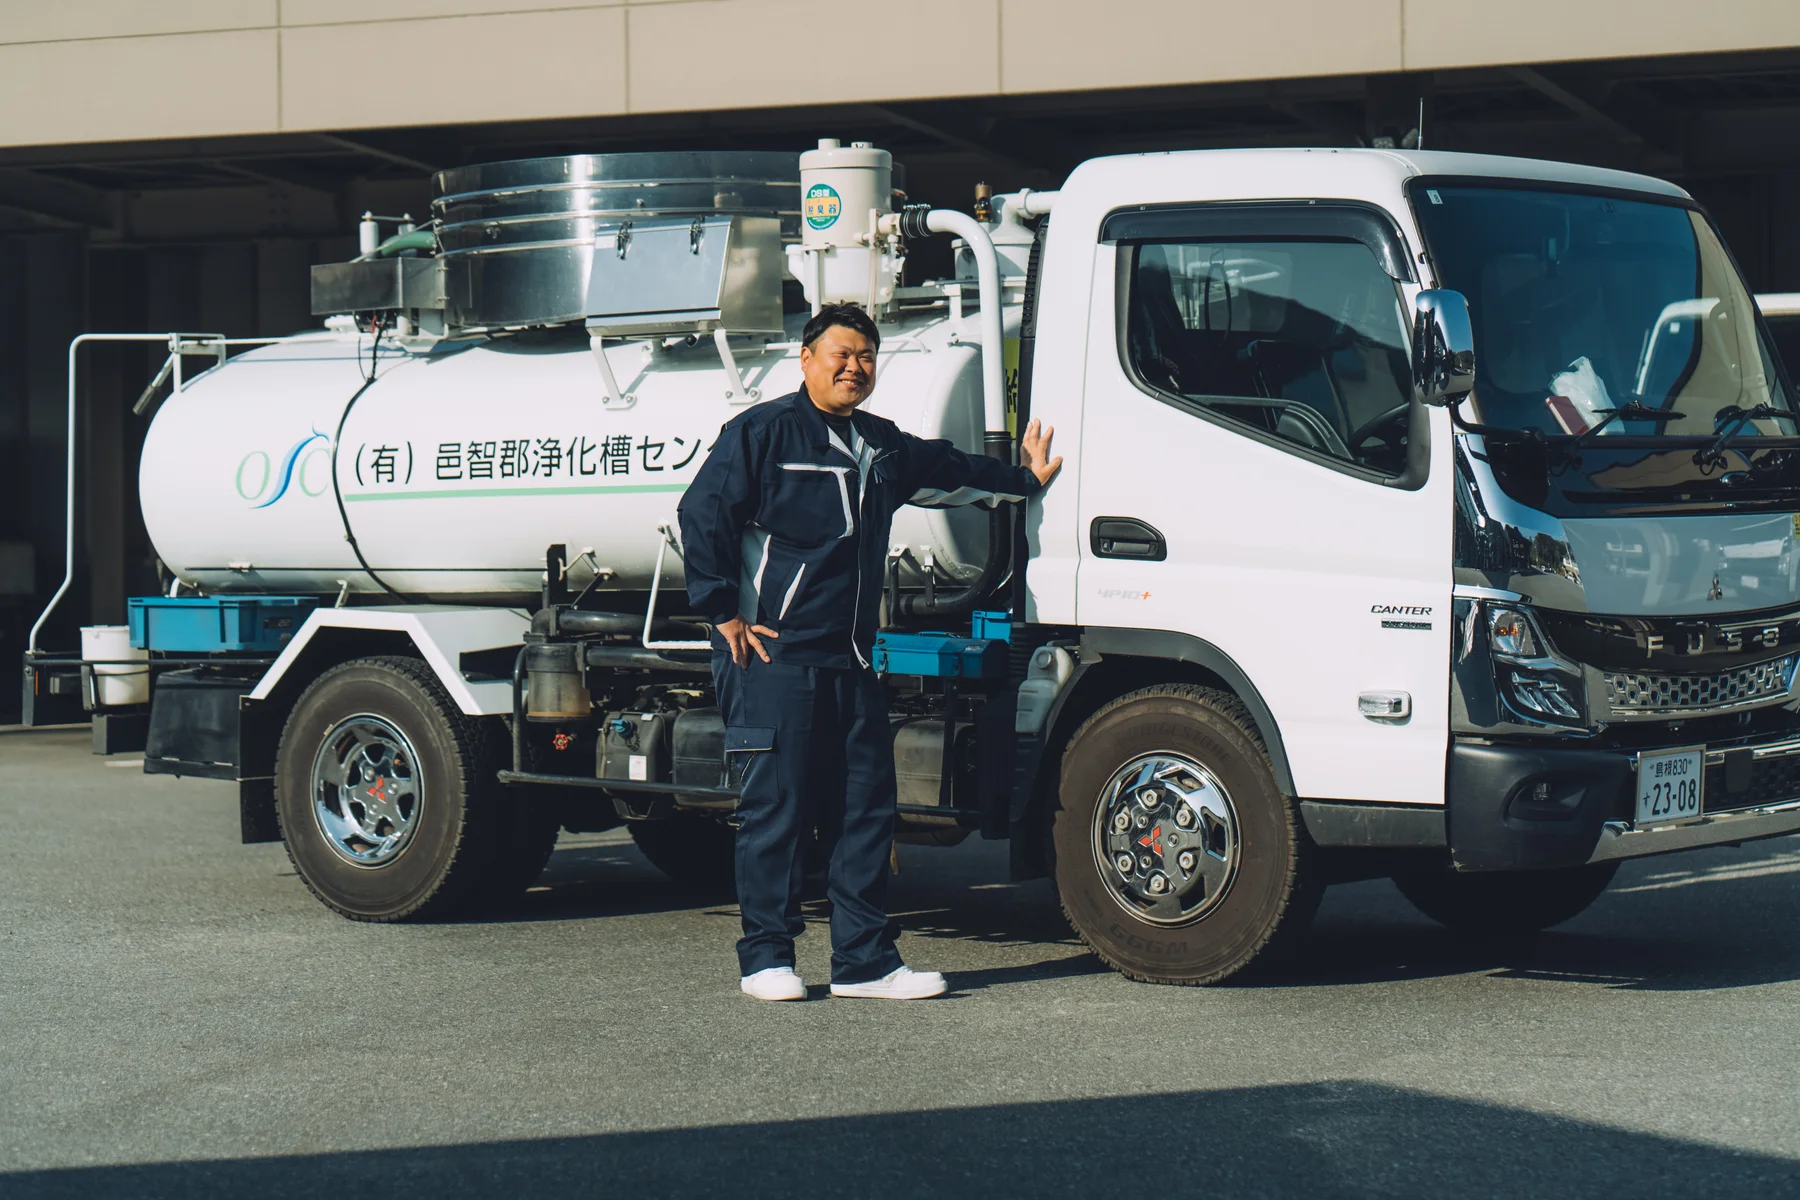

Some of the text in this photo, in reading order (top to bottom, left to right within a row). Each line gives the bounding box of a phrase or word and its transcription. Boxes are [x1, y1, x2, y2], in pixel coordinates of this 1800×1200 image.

[355, 434, 712, 486] （有）邑智郡浄化槽セン
[1370, 604, 1433, 616] CANTER
[1646, 627, 1780, 659] FUSO
[1652, 778, 1697, 816] 23-08
